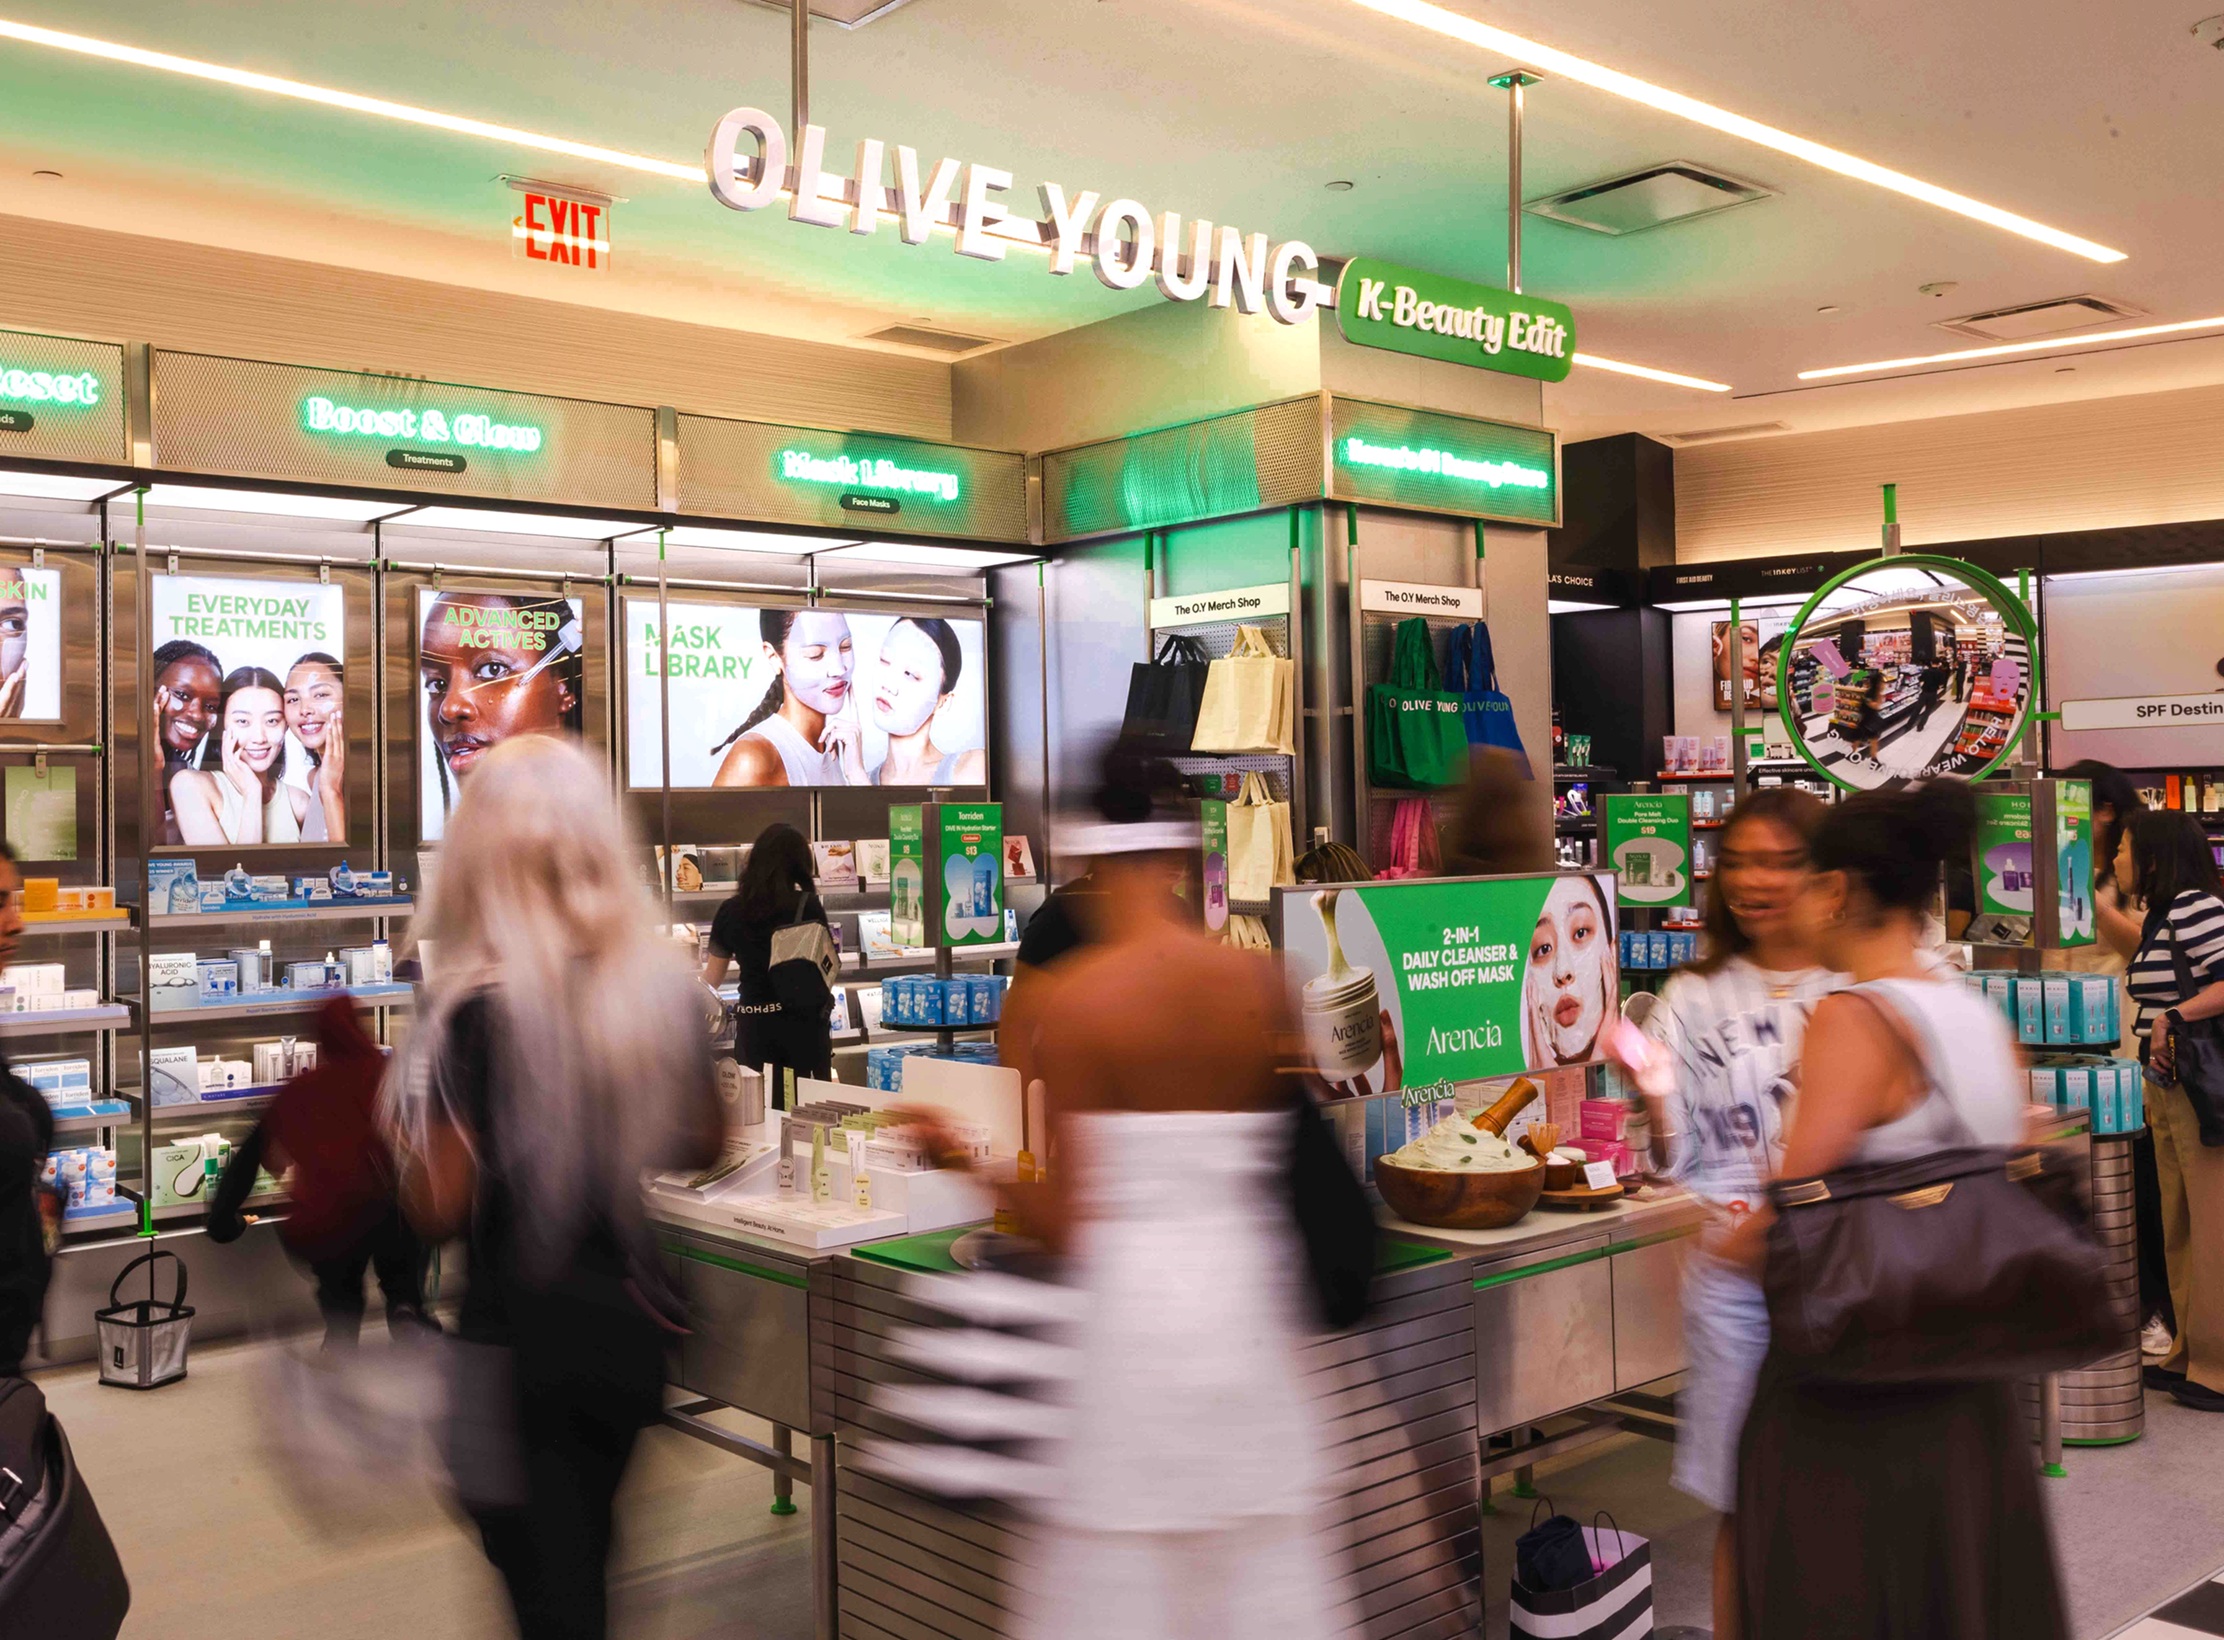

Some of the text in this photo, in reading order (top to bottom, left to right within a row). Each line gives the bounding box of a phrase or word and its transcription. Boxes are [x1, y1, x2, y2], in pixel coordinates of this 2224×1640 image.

[706, 106, 1319, 326] OLIVE YOUNG
[525, 193, 601, 269] EXIT
[1356, 277, 1568, 359] K-Beauty Edit
[0, 367, 99, 405] eset
[306, 396, 541, 452] Boost & Glow
[402, 453, 454, 467] Treatments
[852, 497, 891, 509] Face Masks
[1564, 575, 1593, 587] CHOICE
[187, 593, 311, 618] EVERYDAY
[1174, 597, 1261, 615] The O.Y Merch Shop
[1385, 590, 1461, 608] The O.Y Merch Shop
[169, 615, 327, 641] TREATMENTS
[443, 605, 561, 631] ADVANCED
[459, 626, 548, 651] ACTIVES
[645, 652, 753, 680] LBRARY
[1401, 700, 1433, 712] OLIVE
[2136, 704, 2167, 718] SPF
[958, 811, 984, 821] Torriden
[1634, 801, 1663, 809] Arencia
[961, 825, 981, 833] Hydration
[1641, 826, 1656, 835] $19
[966, 845, 977, 855] $13
[1443, 925, 1480, 946] 2-IN-1
[1402, 943, 1518, 971] DAILY CLEANSER &
[1408, 964, 1515, 992] WASH OFF MASK
[1331, 1013, 1375, 1043] Arencia
[1426, 1019, 1502, 1056] Arencia
[1400, 1077, 1455, 1109] Arencia
[166, 1154, 185, 1162] CICA
